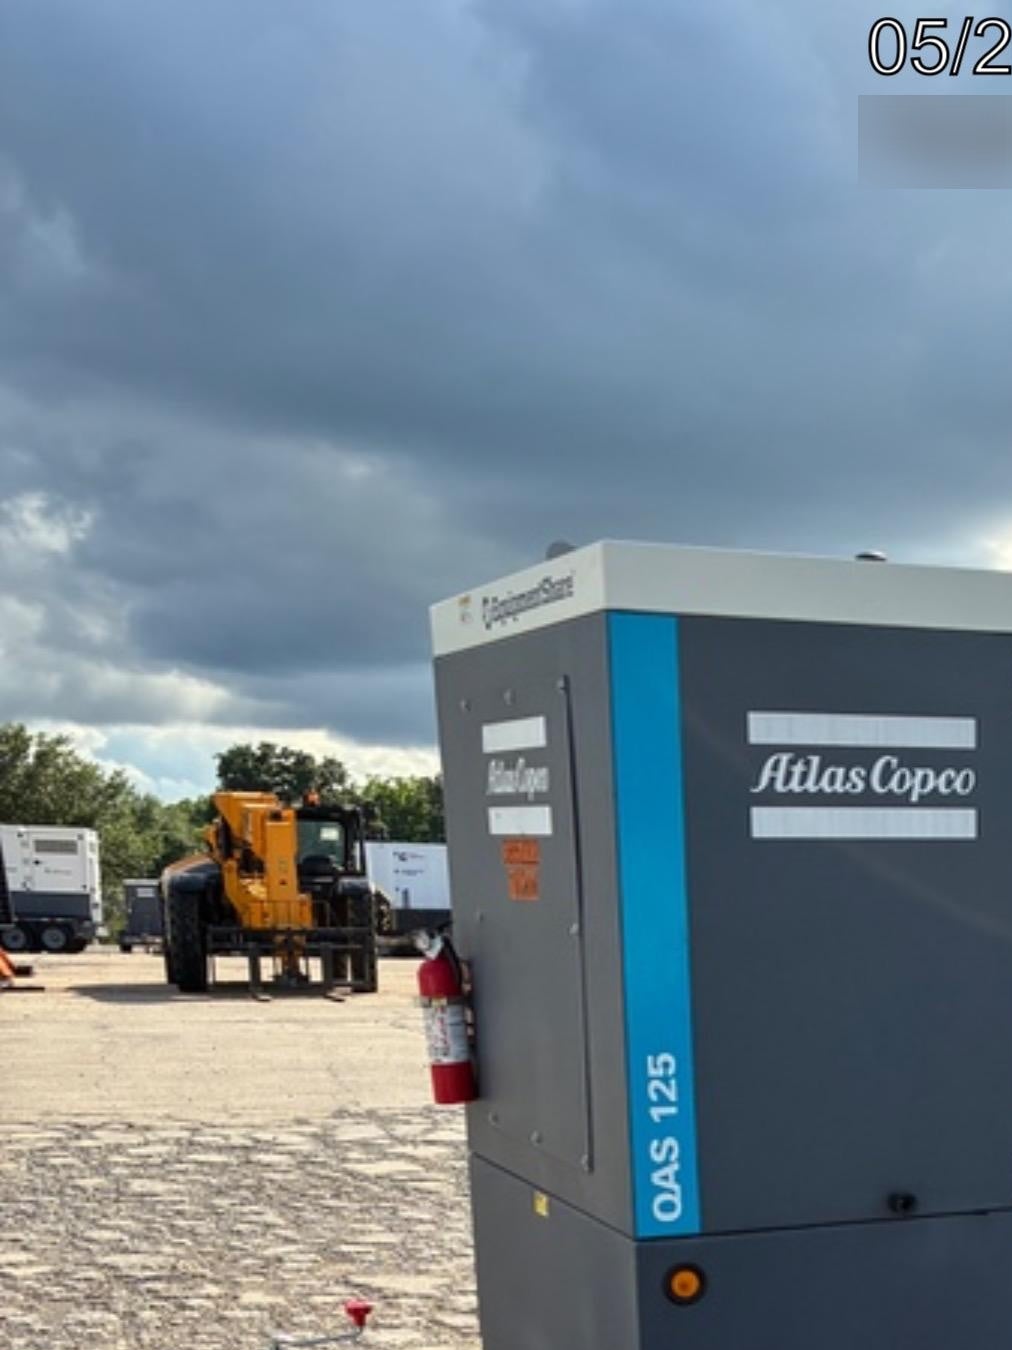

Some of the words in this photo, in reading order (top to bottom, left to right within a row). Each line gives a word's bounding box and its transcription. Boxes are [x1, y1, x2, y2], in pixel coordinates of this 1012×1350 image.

[750, 752, 866, 794] Atlas
[869, 754, 976, 803] Copco
[647, 1053, 678, 1122] 125
[650, 1136, 682, 1222] QAS
